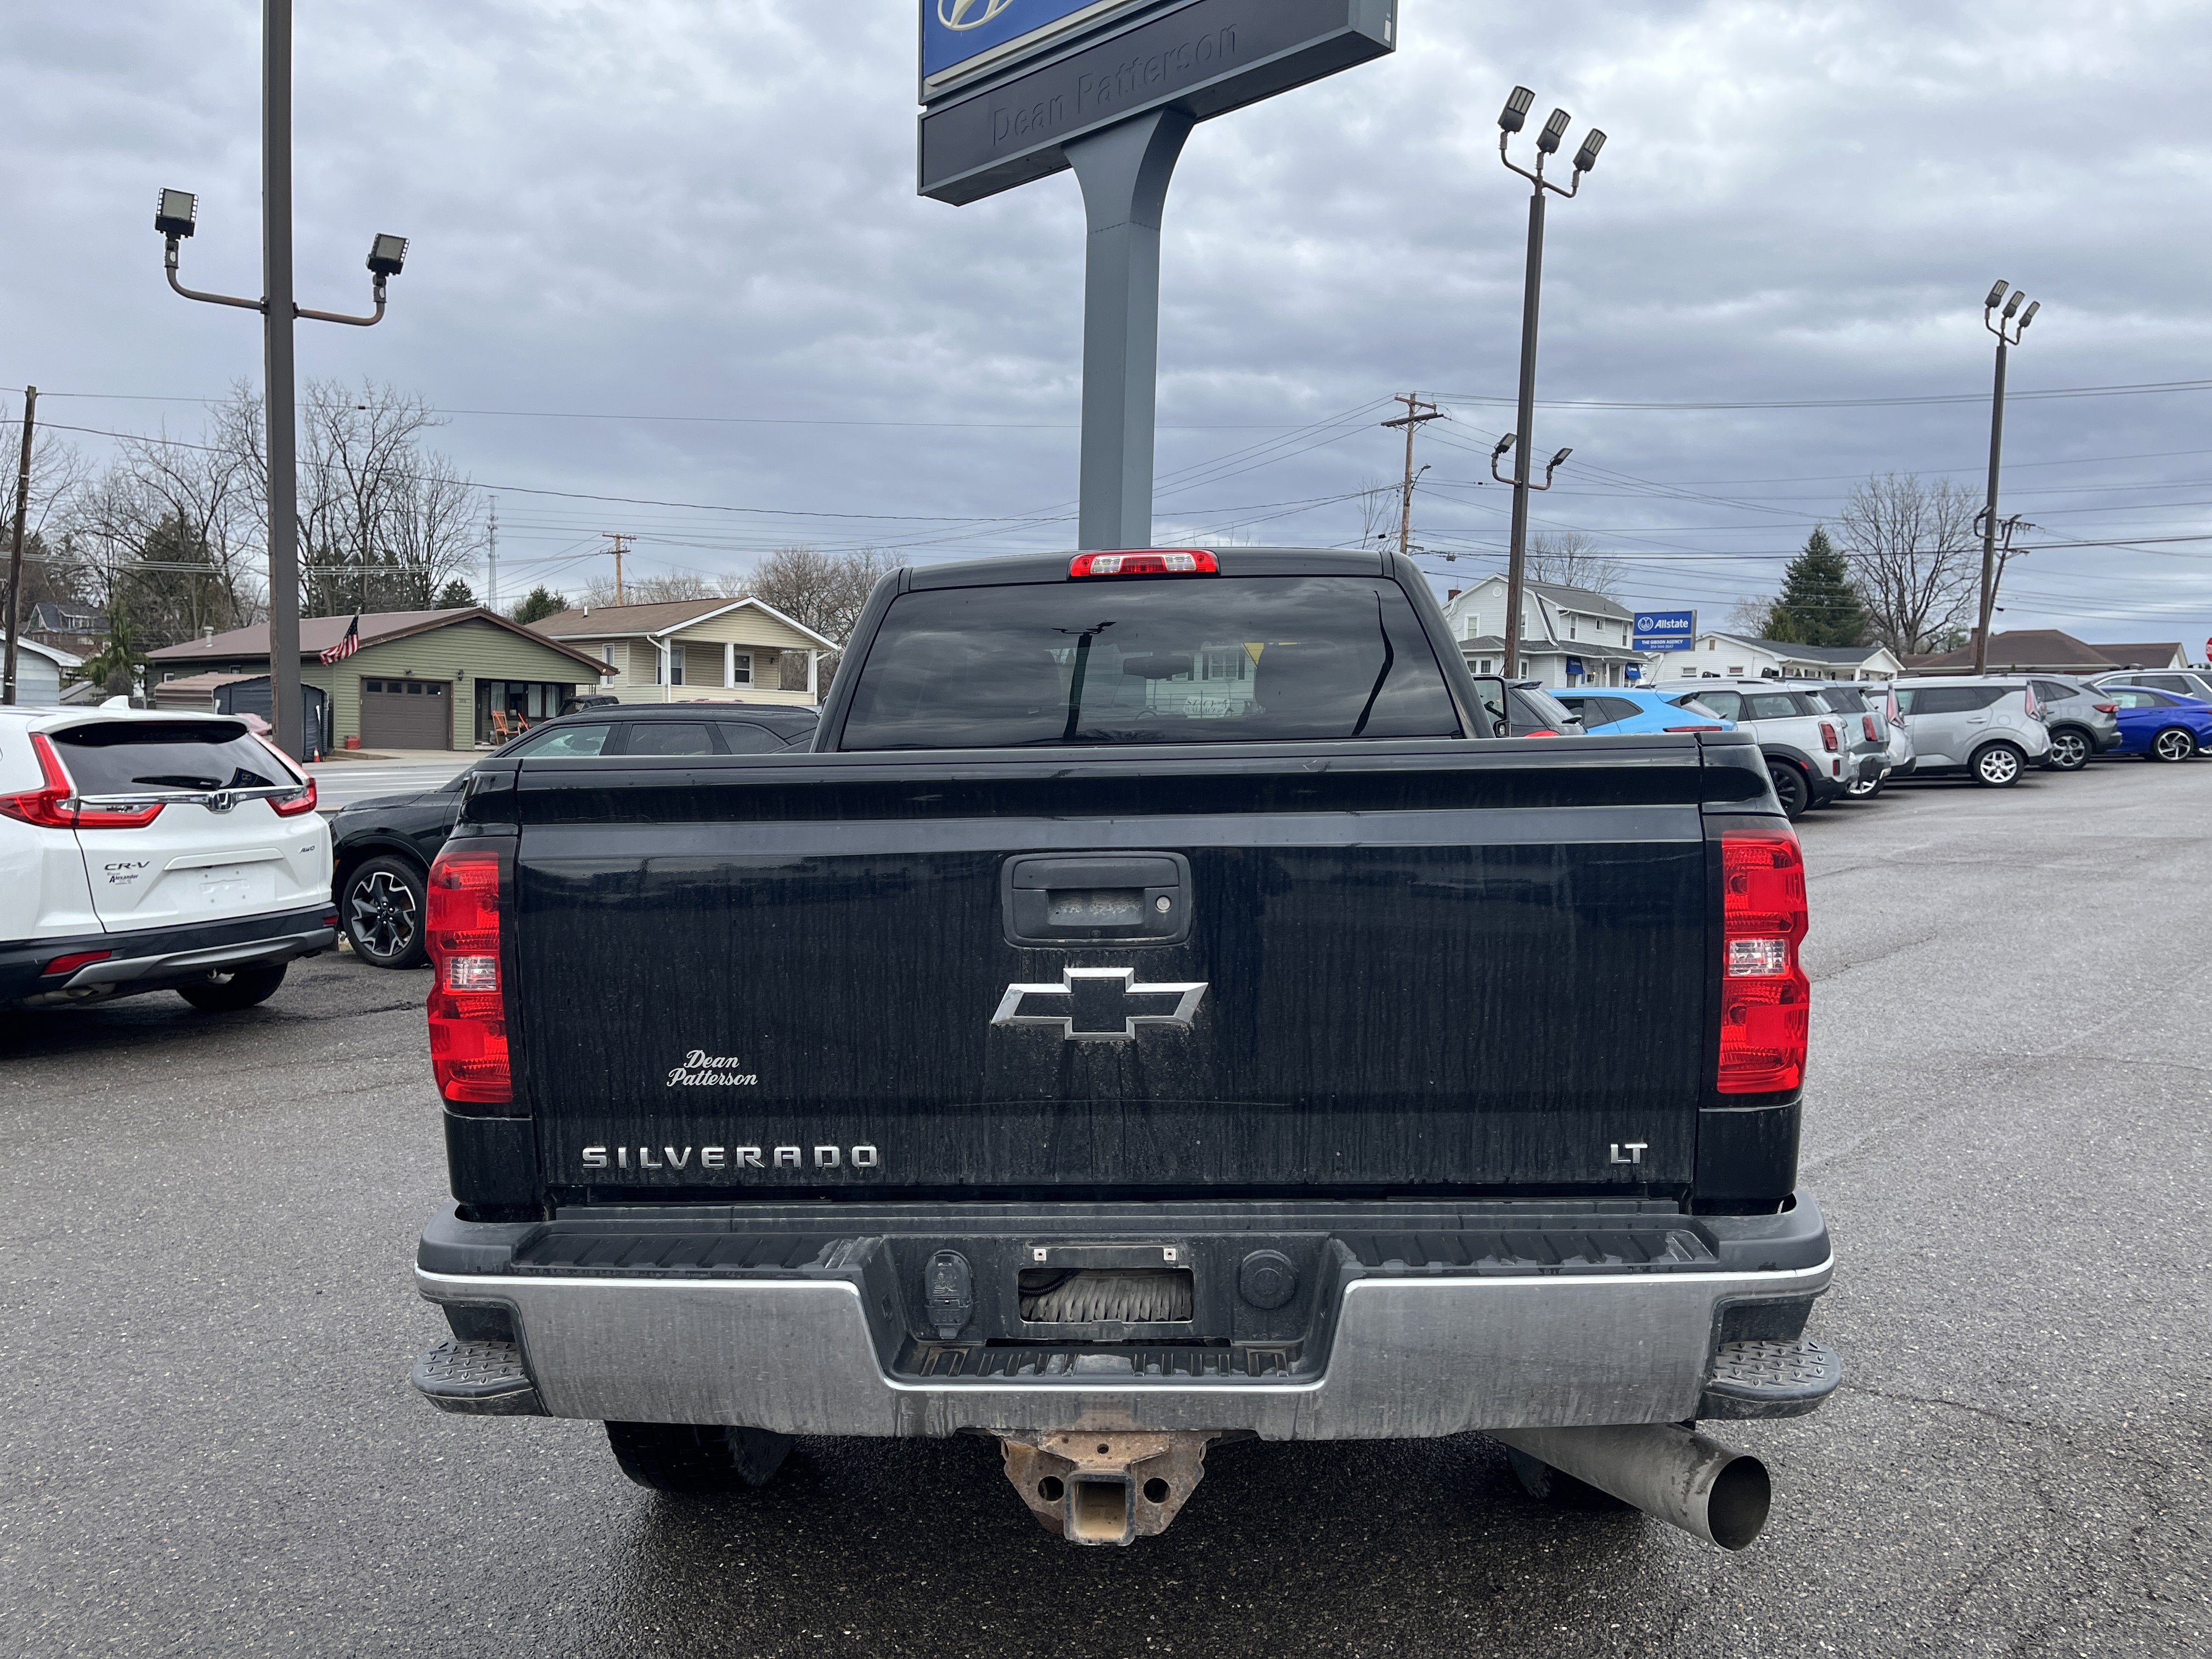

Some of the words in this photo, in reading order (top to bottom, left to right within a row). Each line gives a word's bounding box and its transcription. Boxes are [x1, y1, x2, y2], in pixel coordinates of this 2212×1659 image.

[994, 94, 1063, 146] Dean
[1077, 23, 1237, 113] Patterson
[1654, 618, 1689, 629] Allstate
[298, 845, 315, 854] AWD
[104, 861, 150, 870] CR-V
[109, 873, 139, 883] Alexander
[683, 1049, 740, 1068] Dean
[666, 1068, 758, 1087] Patterson
[582, 1146, 878, 1169] SILVERADO
[1610, 1143, 1648, 1164] LT
